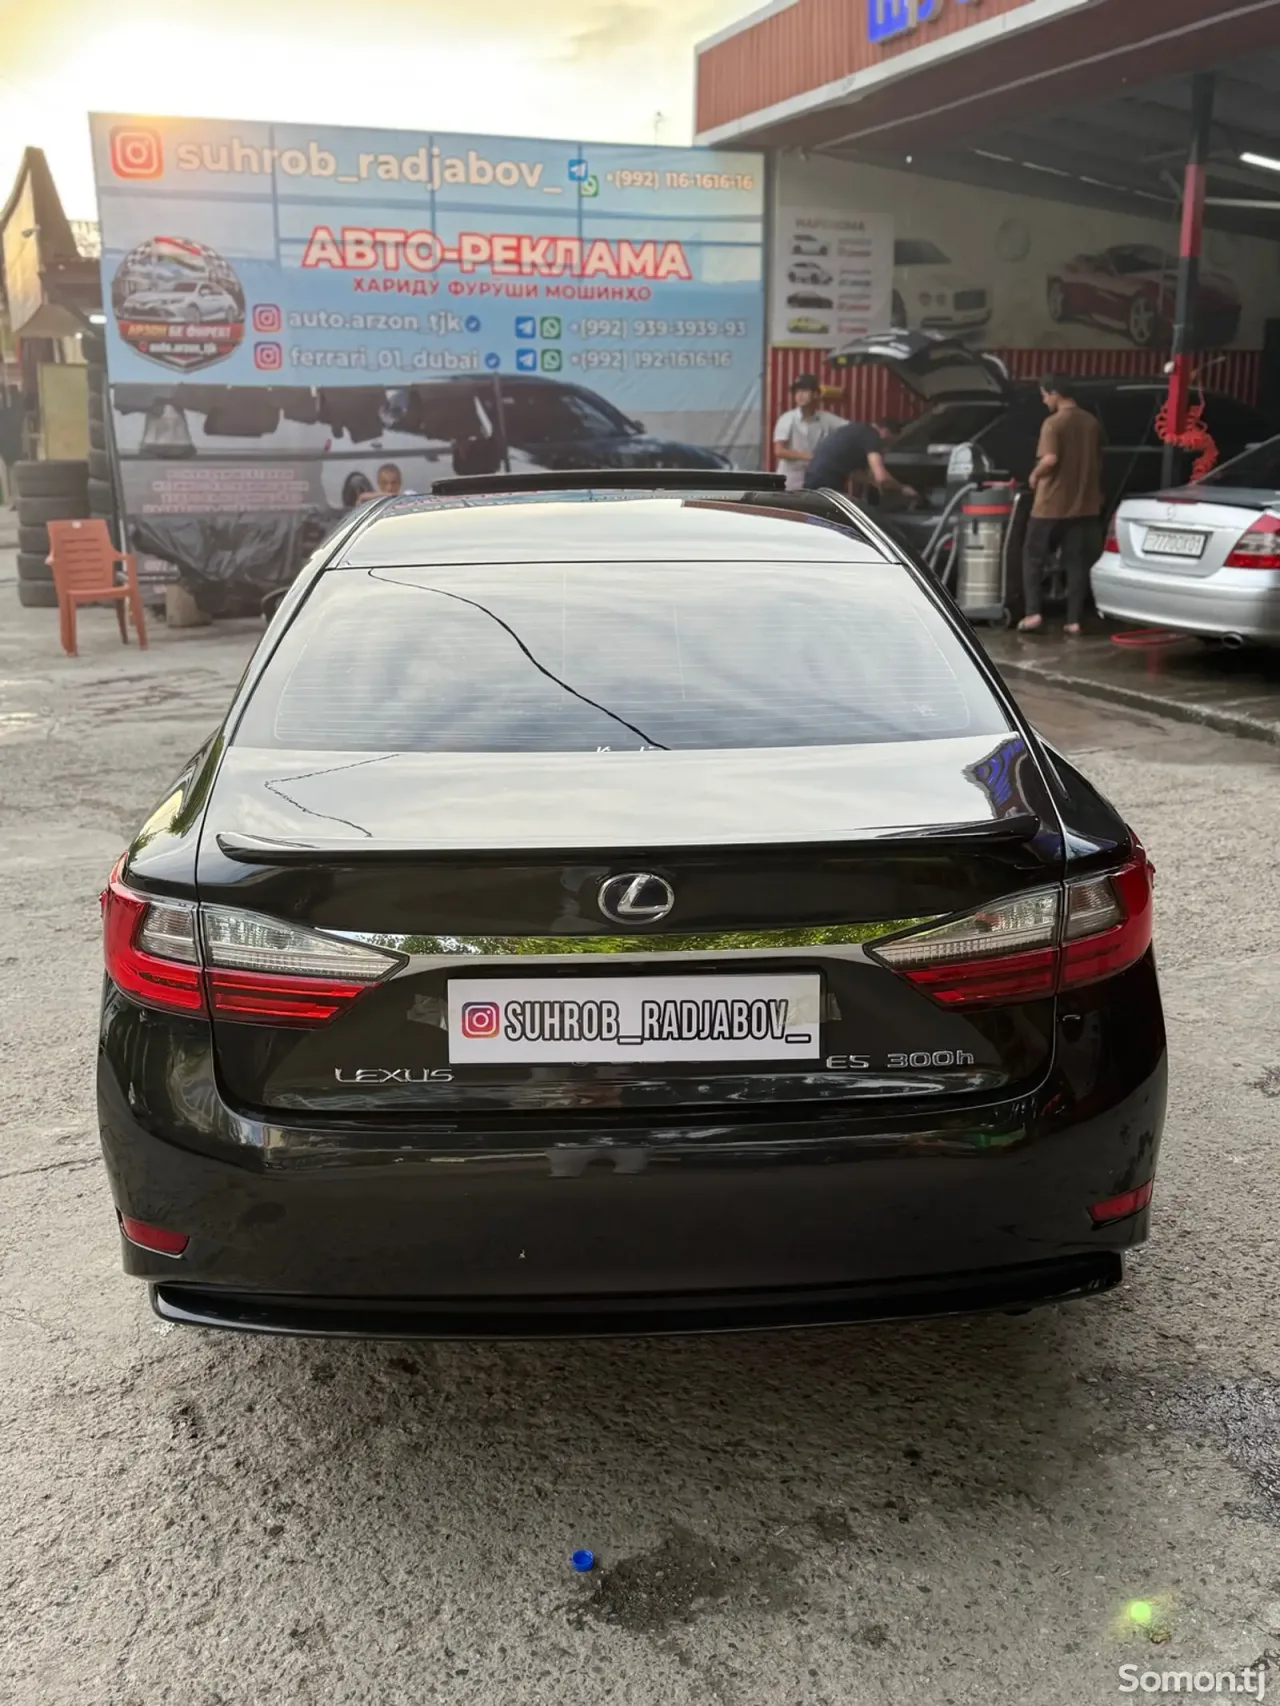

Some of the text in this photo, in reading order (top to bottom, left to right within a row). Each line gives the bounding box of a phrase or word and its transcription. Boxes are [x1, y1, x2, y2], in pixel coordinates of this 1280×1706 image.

[177, 136, 563, 193] suhrob_radjabov_
[302, 225, 692, 280] АВТО-РЕКЛАМА
[353, 277, 440, 296] ХАРИДУ
[447, 280, 539, 298] ФУРУШИ
[288, 310, 462, 335] auto.arzon_tjk
[633, 319, 747, 338] 939-3939-93
[290, 346, 479, 371] ferrari_01_dubai
[634, 351, 732, 370] 192-1616-16
[504, 1000, 811, 1045] SUHROB_RADJABOV_
[826, 1050, 974, 1069] ES 300h
[335, 1067, 454, 1083] LEXUS
